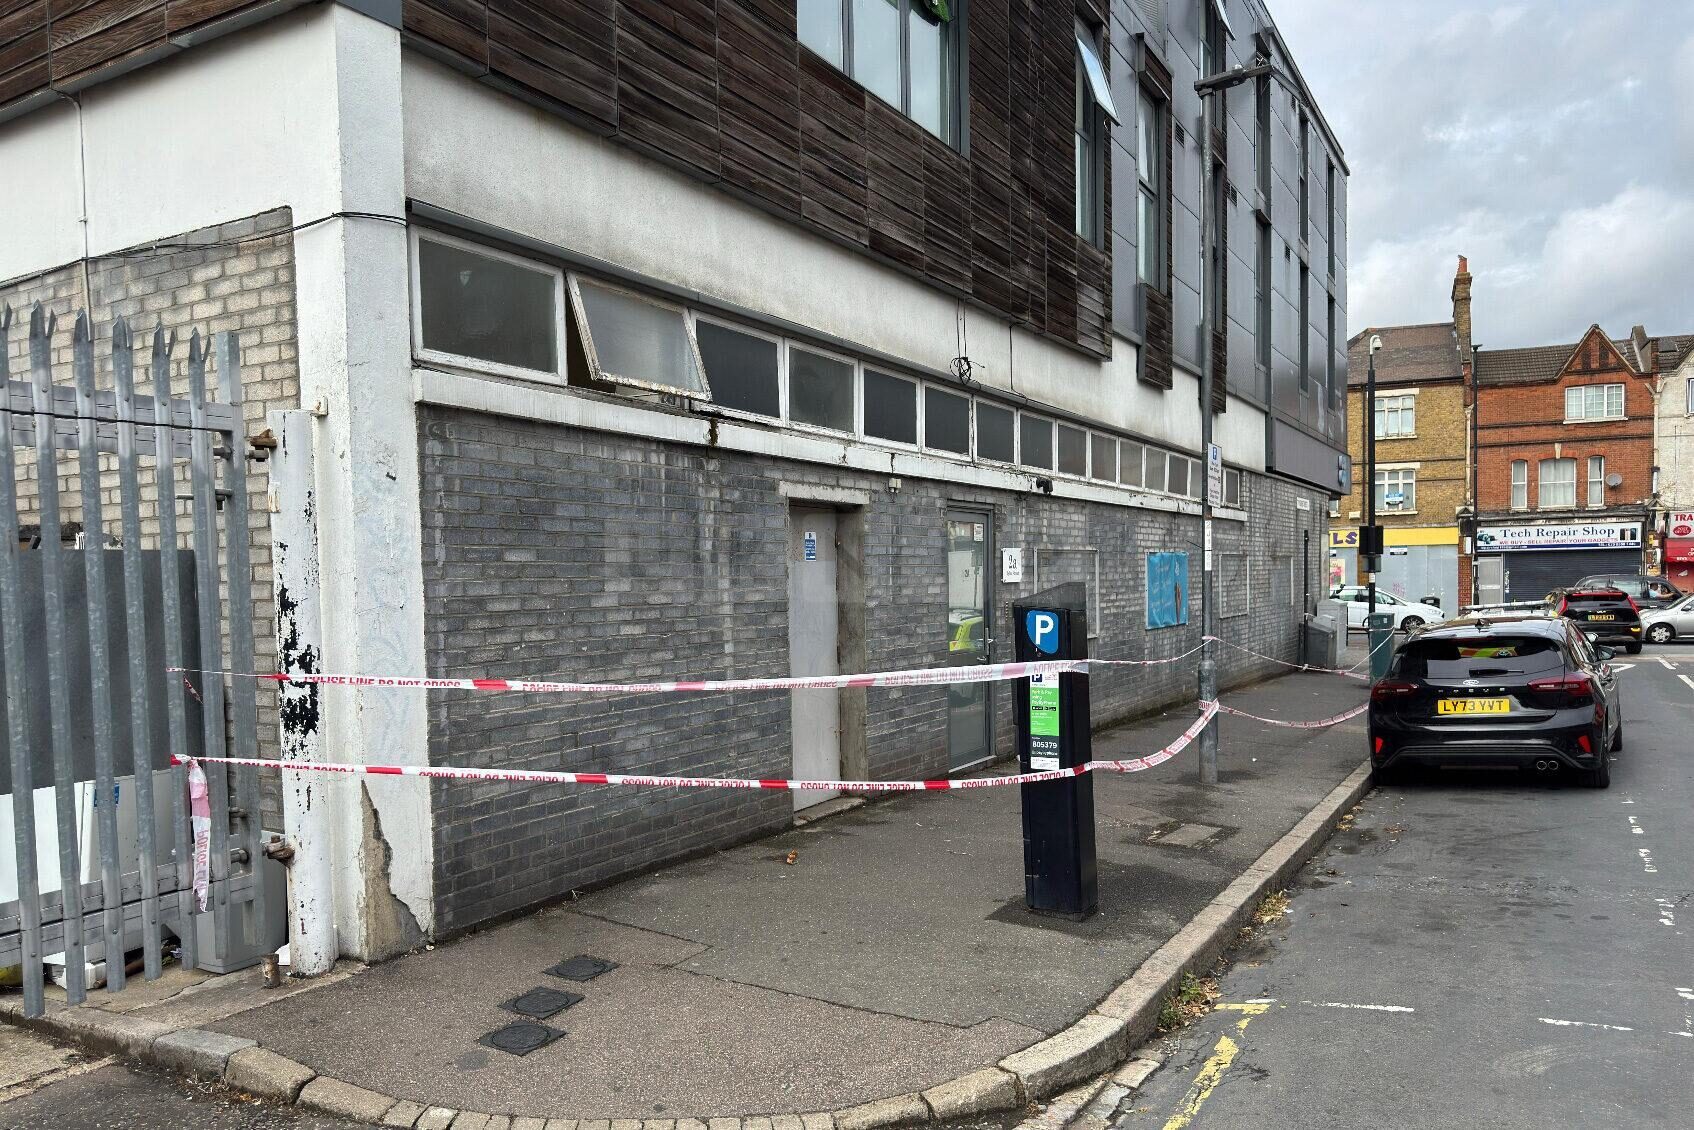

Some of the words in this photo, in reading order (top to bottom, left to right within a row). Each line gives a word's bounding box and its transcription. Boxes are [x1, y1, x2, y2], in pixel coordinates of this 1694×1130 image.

[1500, 528, 1531, 538] Tech
[1536, 527, 1578, 539] Repair
[1582, 526, 1615, 538] Shop
[1035, 615, 1054, 644] P
[1444, 701, 1475, 711] LY73
[1479, 701, 1503, 710] YVT
